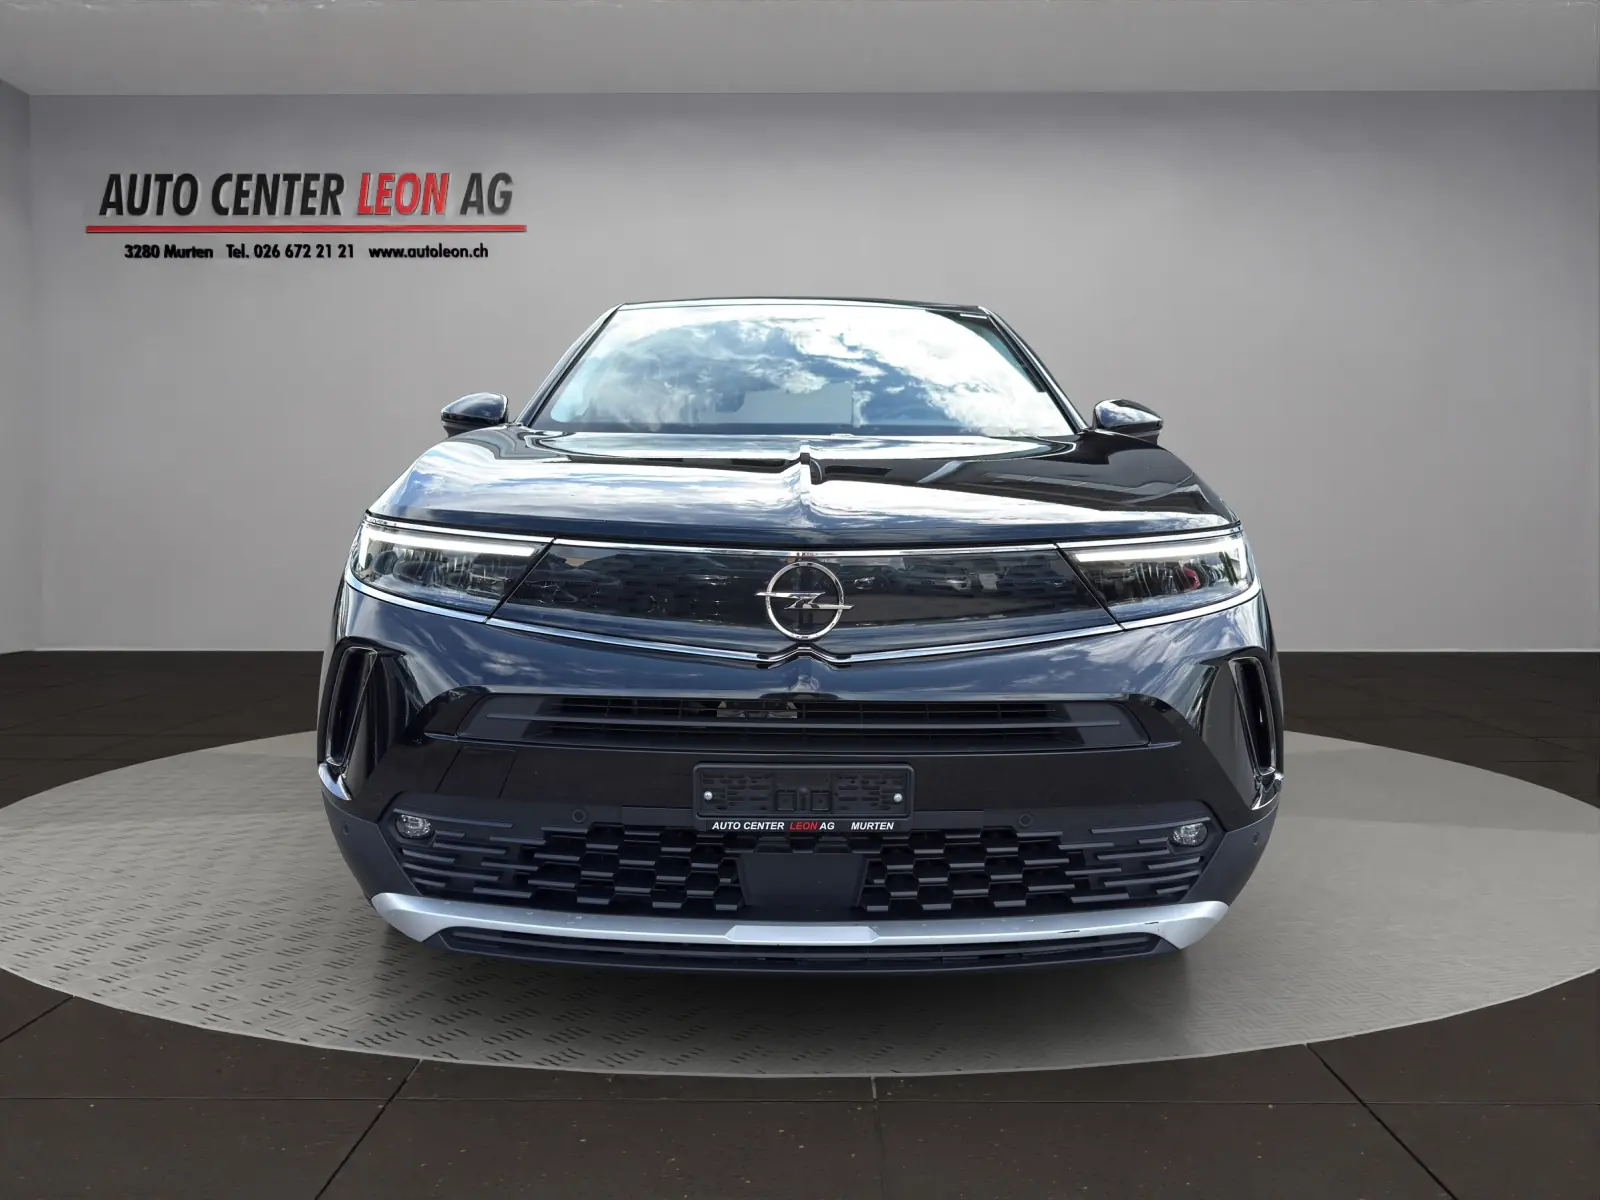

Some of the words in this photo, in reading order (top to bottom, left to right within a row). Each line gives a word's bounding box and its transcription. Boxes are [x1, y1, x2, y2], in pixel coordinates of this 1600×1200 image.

[99, 173, 199, 216] AUTO
[211, 173, 345, 216] CENTER
[357, 173, 449, 215] LEON
[459, 172, 514, 215] AG
[124, 244, 161, 259] 3280
[164, 244, 214, 259] Murten
[226, 244, 250, 259] Tel.
[254, 244, 281, 259] 026
[285, 244, 312, 259] 672
[315, 244, 332, 259] 21
[336, 244, 354, 259] 21
[368, 243, 489, 259] www.autoleon.ch
[712, 821, 741, 830] AUTO
[743, 821, 785, 830] CENTER
[789, 821, 818, 830] LEON
[819, 821, 835, 830] AG
[851, 821, 894, 830] MURTEN
